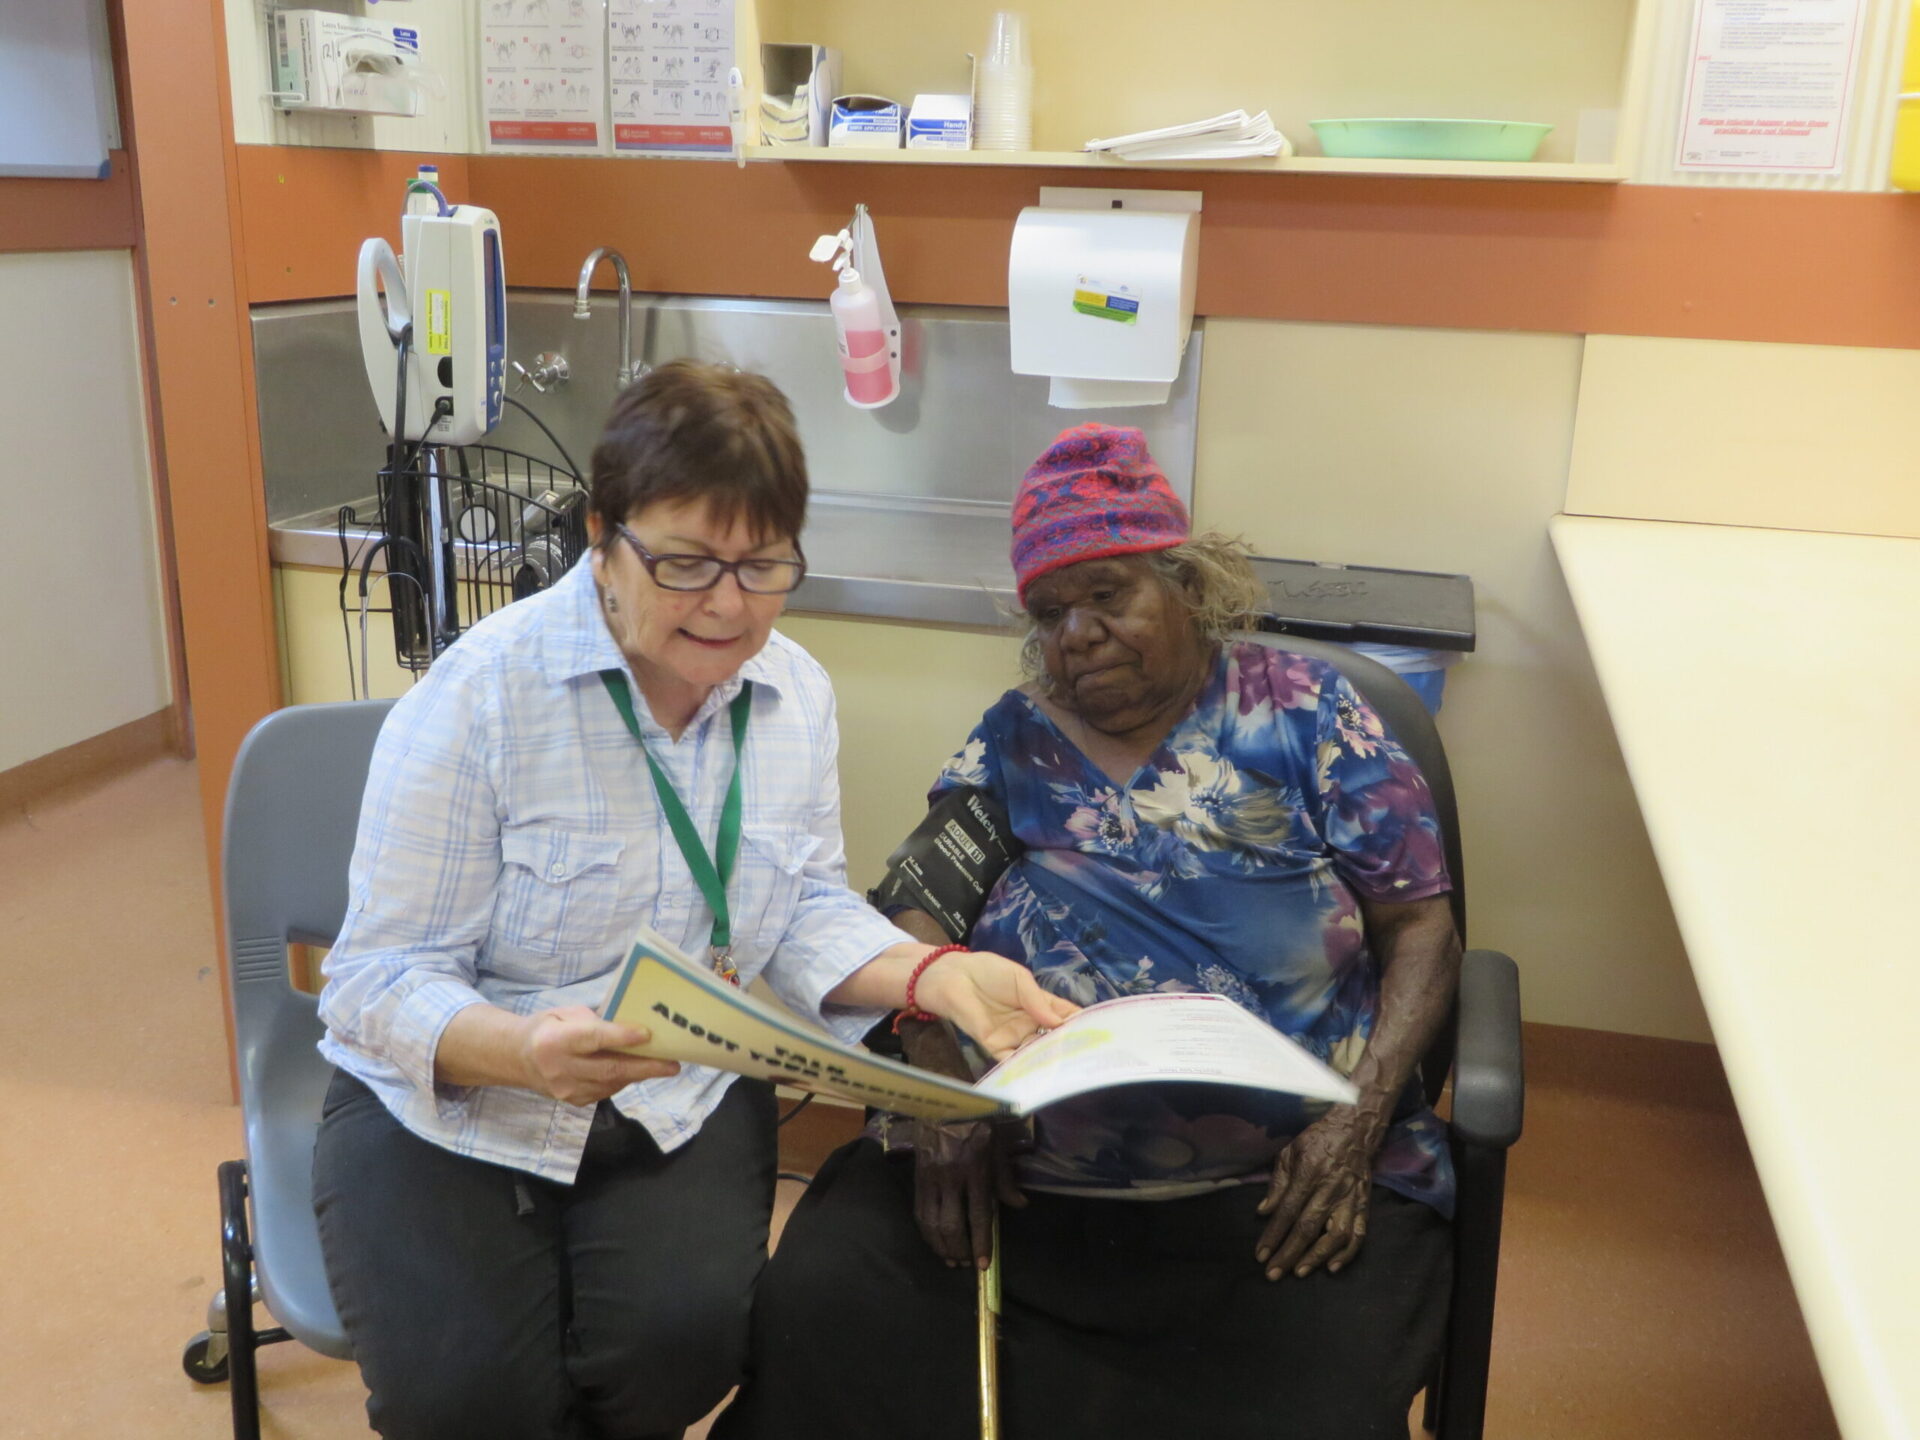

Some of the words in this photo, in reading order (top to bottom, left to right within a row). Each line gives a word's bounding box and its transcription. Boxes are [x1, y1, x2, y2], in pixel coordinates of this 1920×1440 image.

[938, 832, 966, 861] DURABLE
[948, 823, 973, 851] ADULT
[973, 850, 983, 862] 11
[933, 837, 951, 857] Blood
[950, 855, 973, 882] Pressure
[972, 880, 985, 895] Cuff
[651, 1002, 740, 1053] ABOUT
[749, 1050, 820, 1077] YOUR
[775, 1046, 845, 1075] TALK
